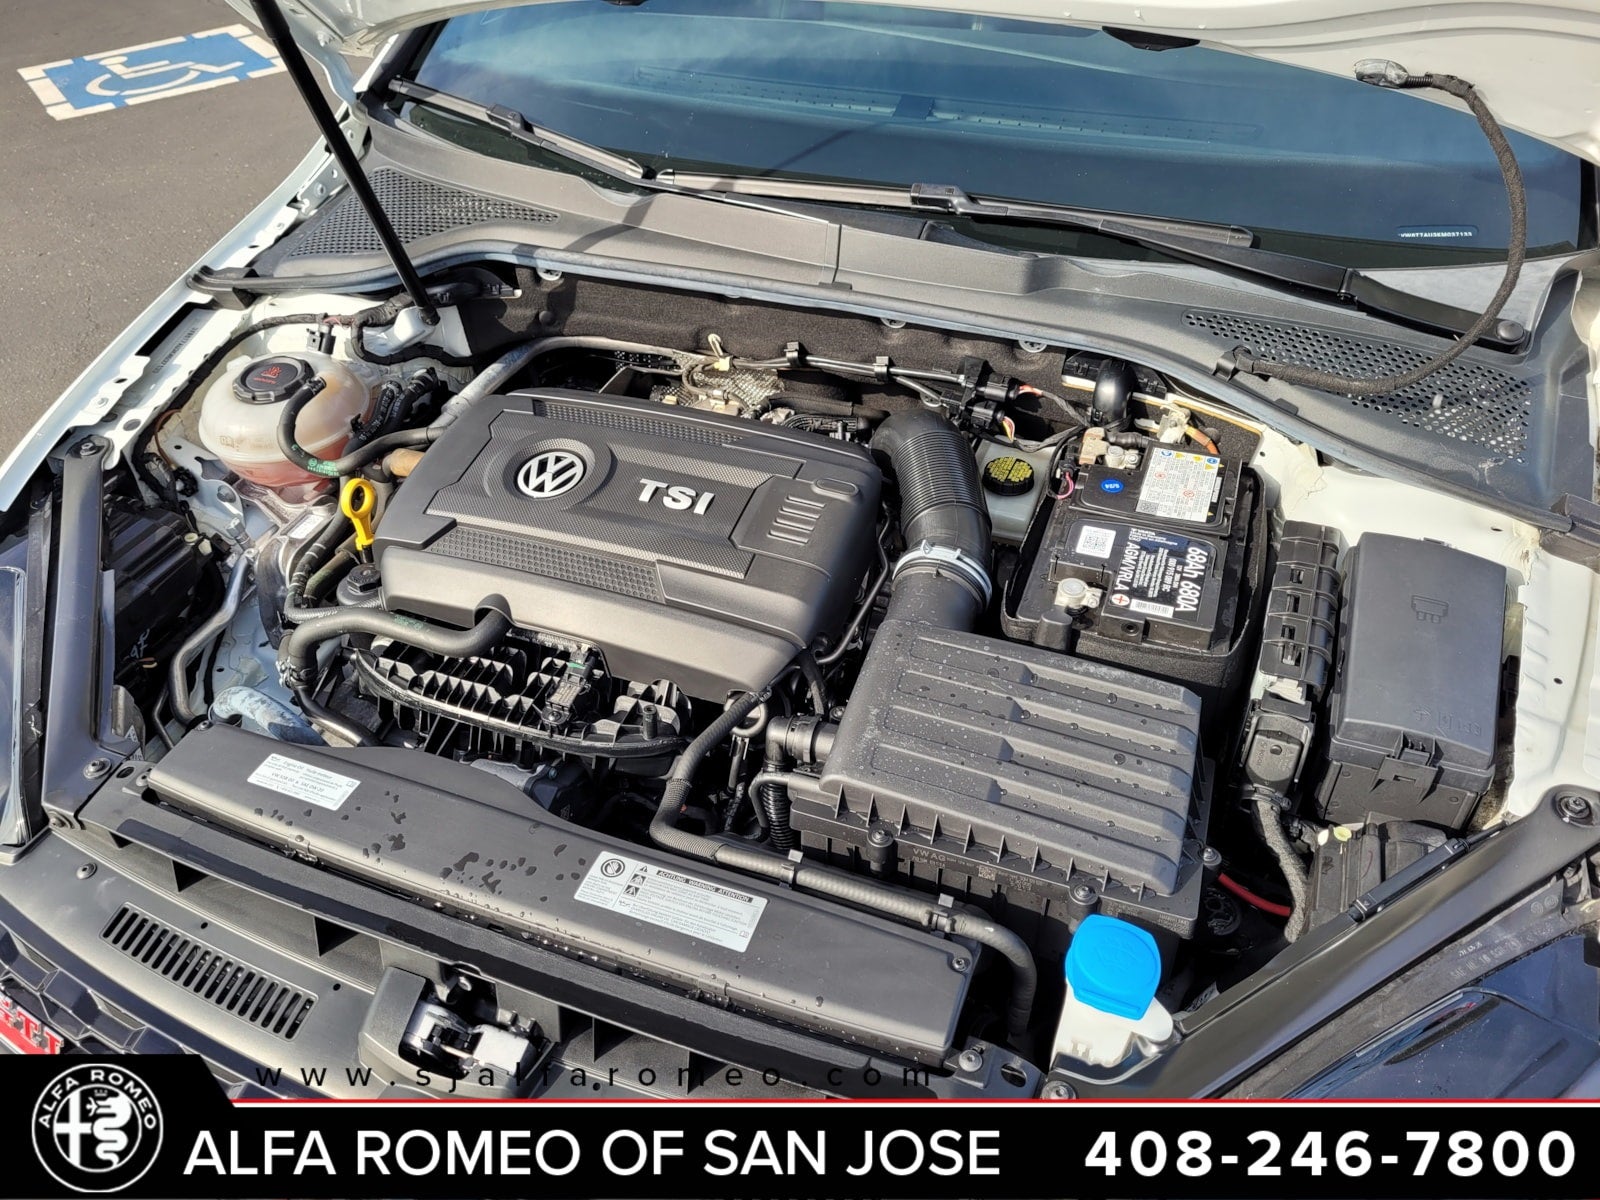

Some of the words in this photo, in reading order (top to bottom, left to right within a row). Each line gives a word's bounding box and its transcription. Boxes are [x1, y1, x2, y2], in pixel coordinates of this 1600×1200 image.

[638, 478, 715, 515] TSI
[1114, 542, 1140, 590] AGM/VRLA
[1183, 547, 1208, 578] 68Ah
[1175, 581, 1201, 611] 680A
[913, 848, 929, 857] VW
[931, 852, 946, 862] AG
[658, 870, 687, 883] ACHTUNG
[688, 879, 716, 892] WARNING
[717, 888, 751, 902] ATTENTION
